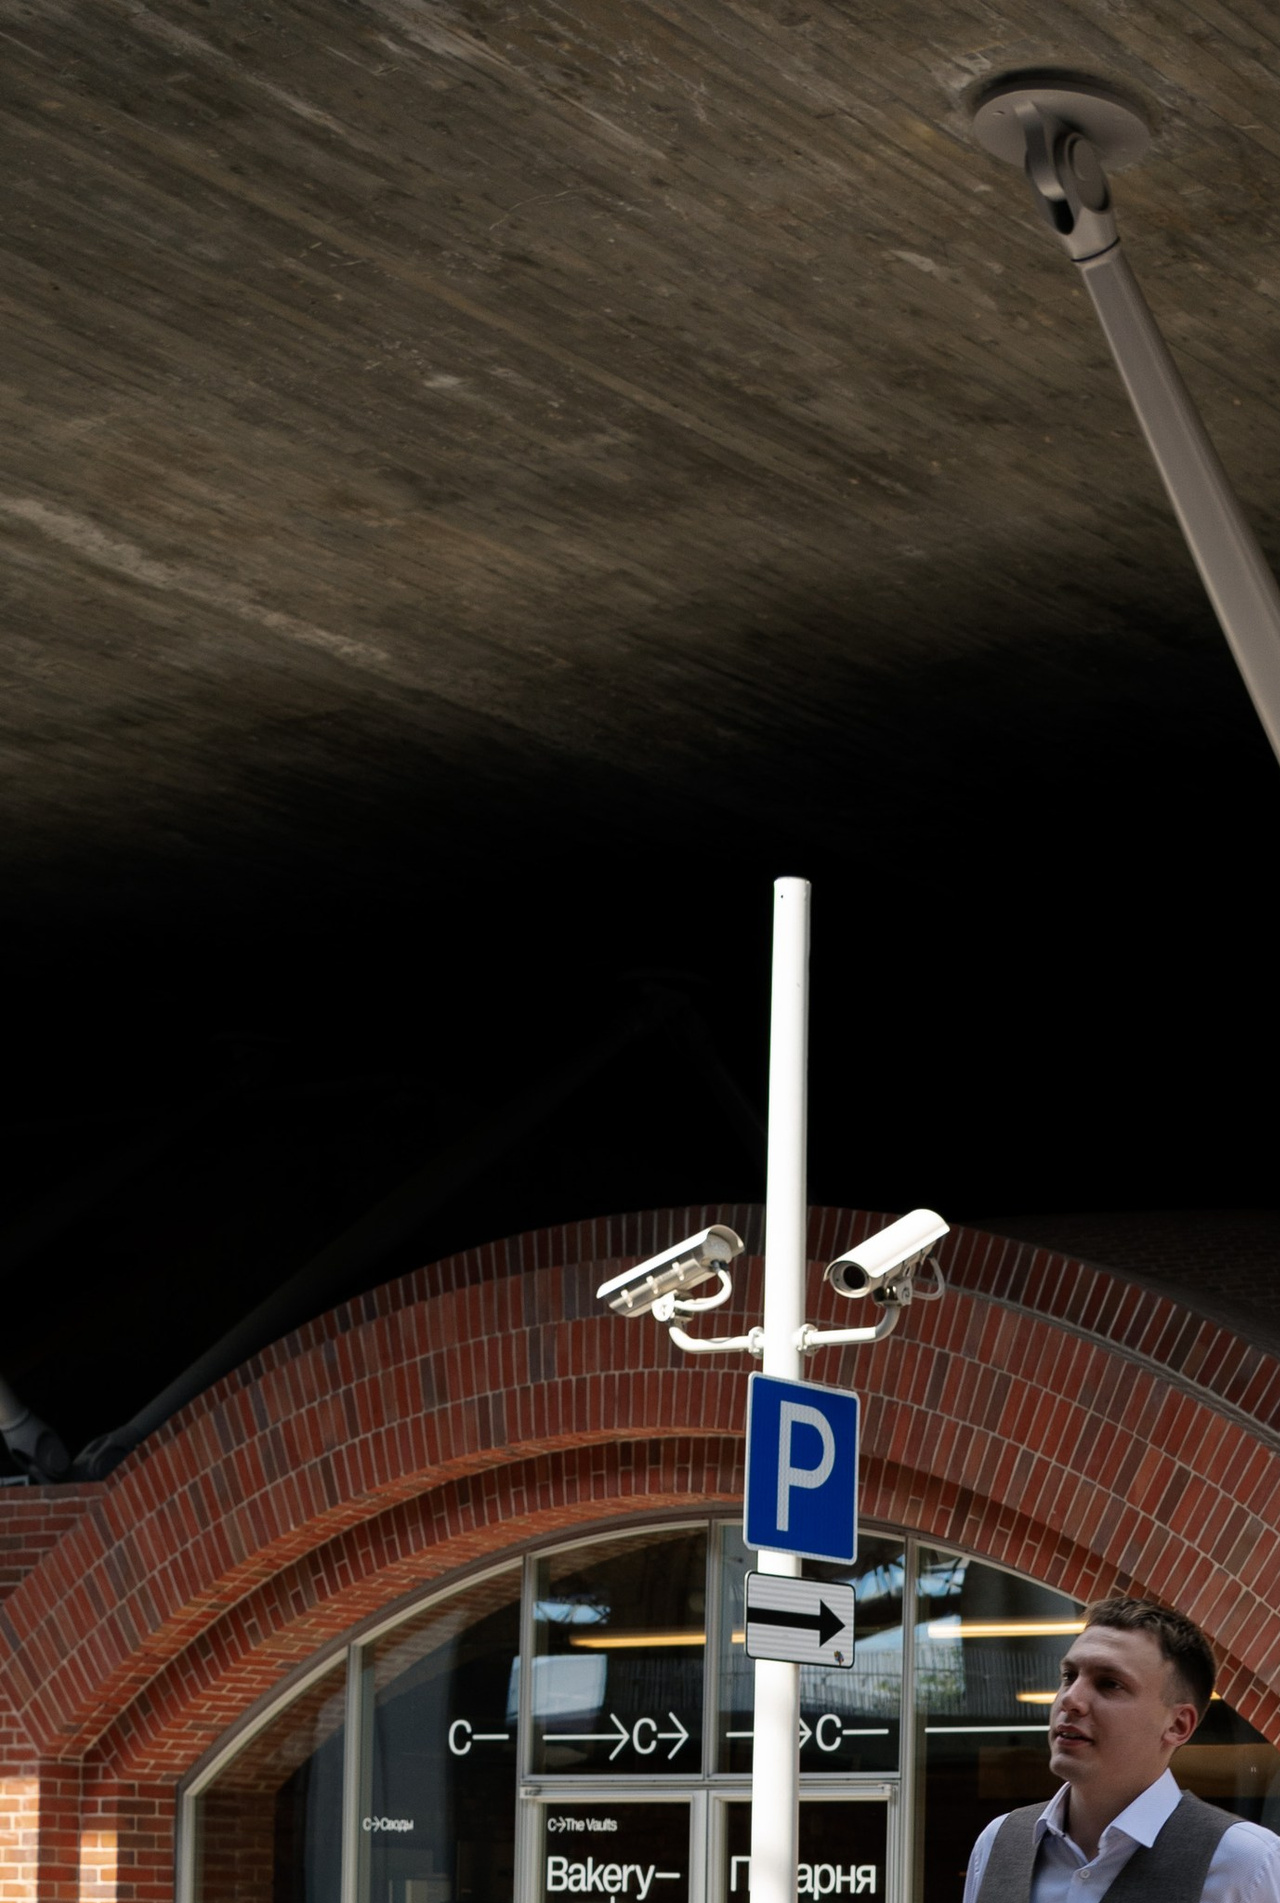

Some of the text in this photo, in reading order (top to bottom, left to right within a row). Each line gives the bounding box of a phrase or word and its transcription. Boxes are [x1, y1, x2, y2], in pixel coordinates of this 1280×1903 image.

[776, 1400, 836, 1532] P
[586, 1818, 618, 1831] Vaults
[730, 1856, 877, 1900] Парня
